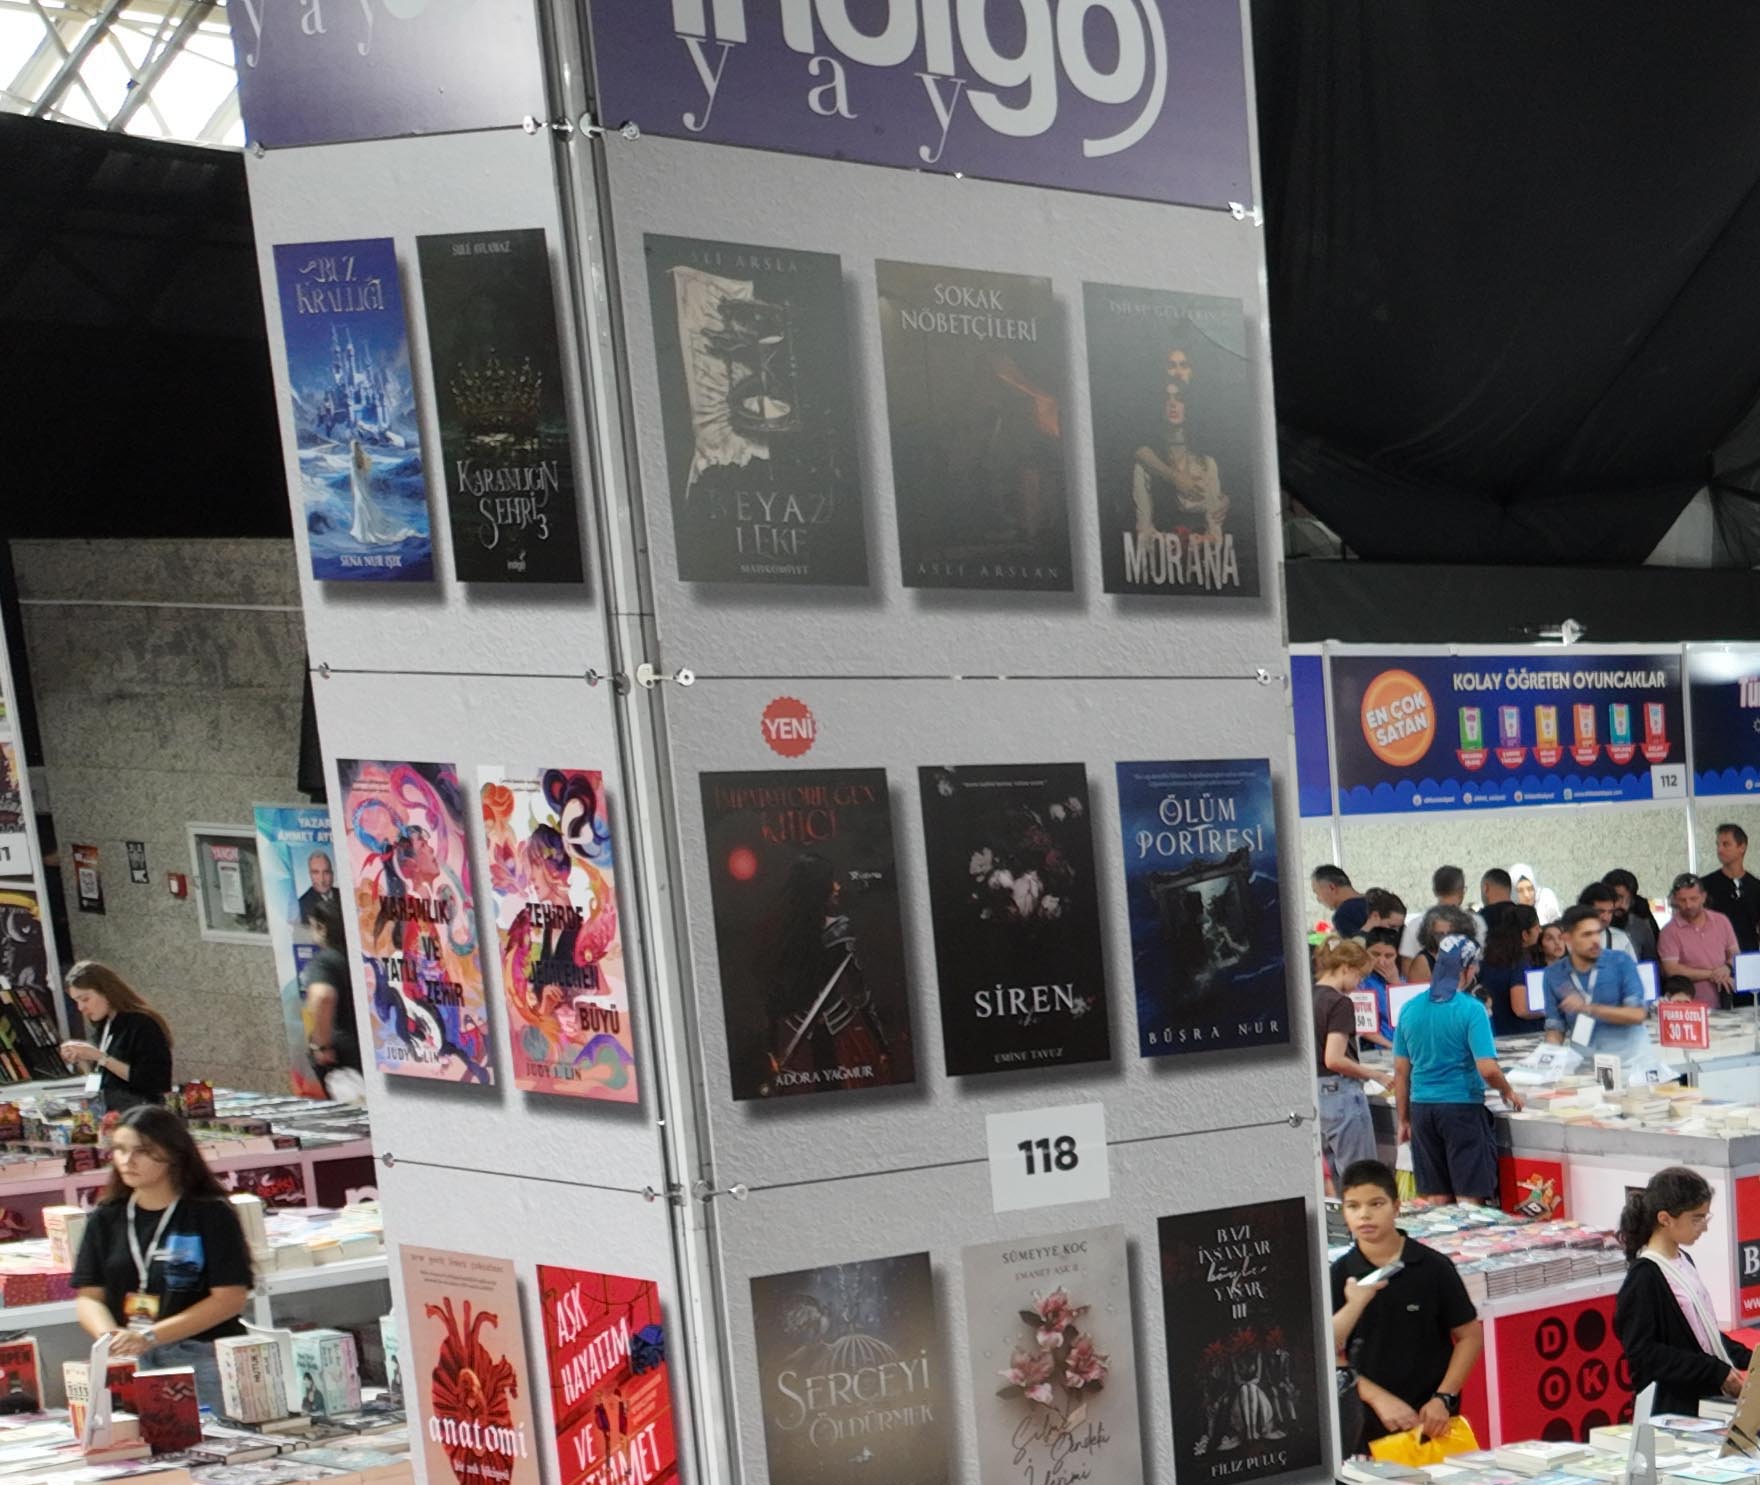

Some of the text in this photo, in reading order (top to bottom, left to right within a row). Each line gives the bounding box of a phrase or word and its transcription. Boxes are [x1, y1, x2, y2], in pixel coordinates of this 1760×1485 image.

[933, 283, 1004, 311] SOKAK
[901, 306, 1038, 343] NÖBETÇİLERİ
[1123, 530, 1240, 591] MORANA
[1453, 668, 1666, 691] KOLAY ÖĞRETEN OYUNCAKLAR
[764, 713, 815, 742] YENİ
[1366, 692, 1427, 729] EN ÇOK
[1376, 711, 1429, 746] SATAN
[1659, 774, 1678, 789] 112
[1159, 792, 1237, 827] ÖLÜM
[1136, 823, 1265, 859] PORTRESİ
[579, 1001, 622, 1035] BÜYÜ
[974, 982, 1075, 1019] SİREN
[1148, 1020, 1280, 1046] BÜŞRA NUR
[1669, 1023, 1697, 1041] 30 TL
[1017, 1134, 1080, 1175] 118
[1001, 1243, 1047, 1264] SÜMEYYE
[555, 1283, 589, 1347] AŞK
[560, 1318, 632, 1406] HAYATIM
[428, 1414, 528, 1460] anatomi
[573, 1423, 598, 1469] VE
